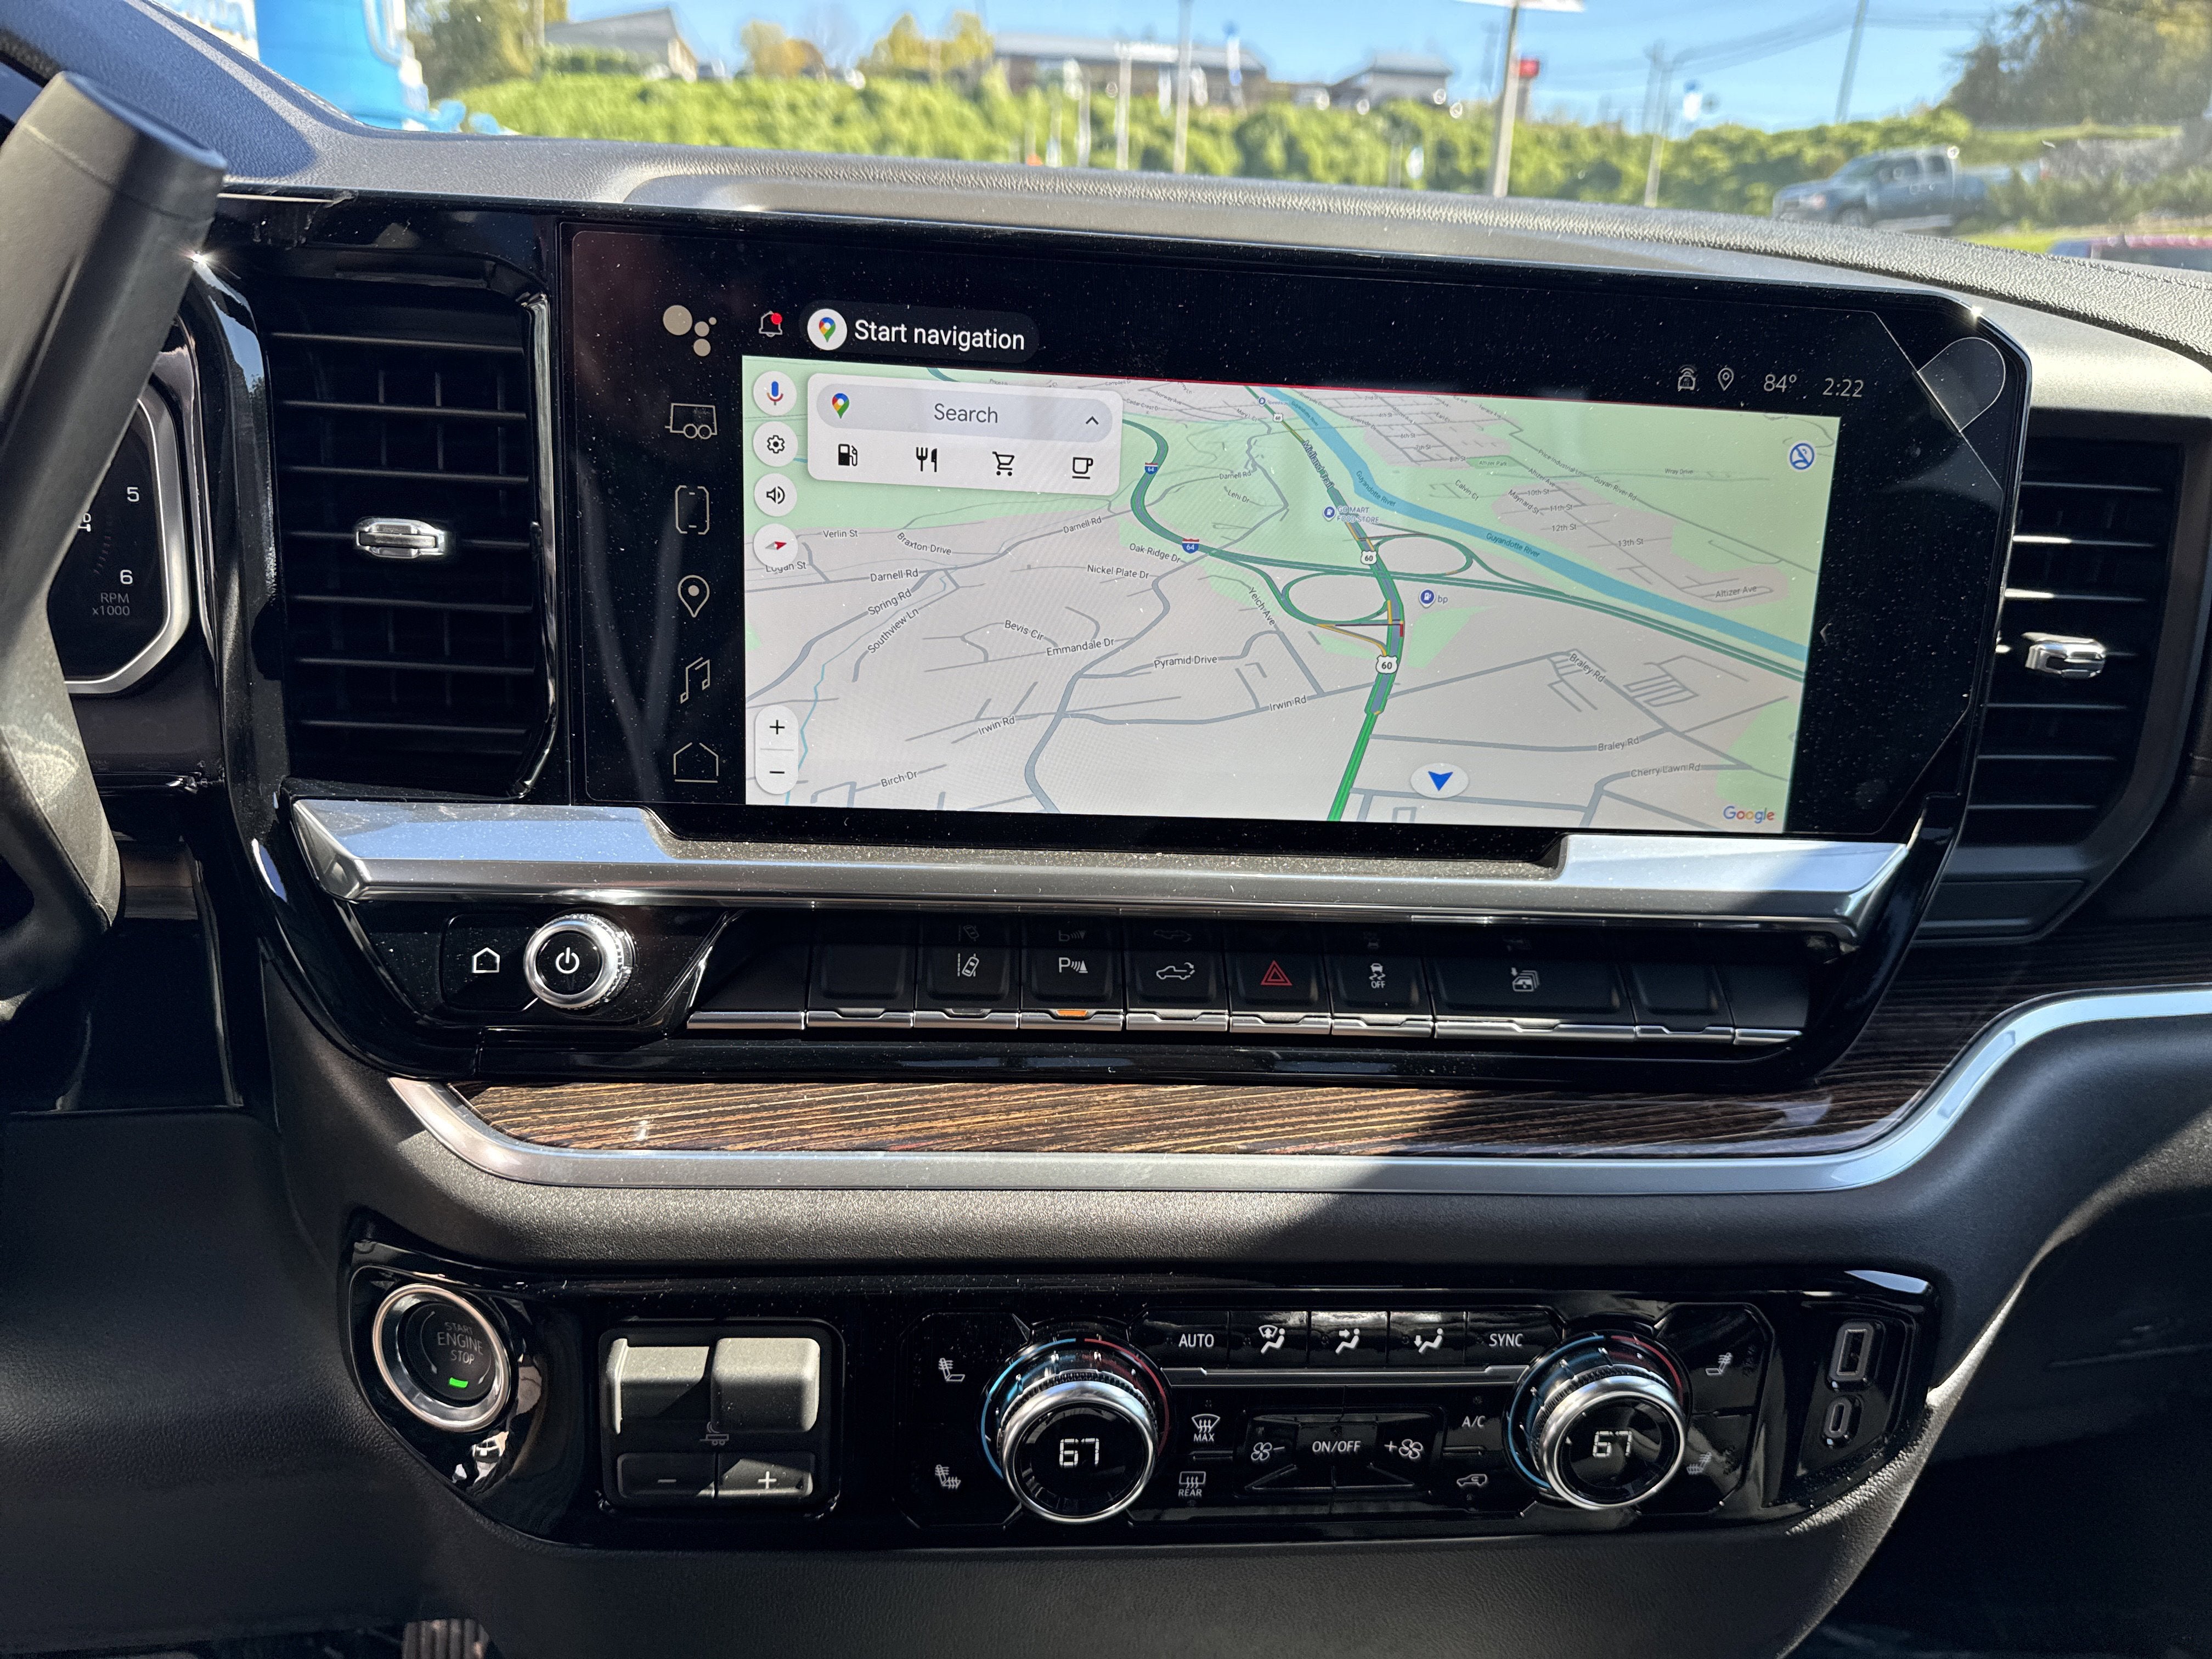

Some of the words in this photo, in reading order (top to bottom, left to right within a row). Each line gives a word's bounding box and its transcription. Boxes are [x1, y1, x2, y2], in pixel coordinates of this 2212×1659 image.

[855, 319, 909, 344] Start
[915, 326, 1025, 352] navigation
[1822, 378, 1864, 398] 2:22
[1155, 391, 1173, 402] Norway
[934, 403, 998, 424] Search
[1350, 416, 1371, 426] Riverside
[1538, 449, 1550, 460] Price
[1303, 440, 1323, 472] Midland
[1321, 470, 1335, 489] Trail
[1356, 470, 1381, 500] Guyandotte
[1380, 494, 1396, 506] River
[1455, 479, 1471, 496] Calvin
[1545, 478, 1555, 487] Ave
[1594, 476, 1612, 489] Guyan
[1613, 485, 1628, 496] River
[1628, 493, 1638, 501] Rd
[127, 487, 140, 502] 5
[1227, 489, 1240, 500] Lehi
[1242, 495, 1250, 503] Dr
[1508, 489, 1534, 510] Maynard
[1533, 506, 1540, 515] St
[1064, 520, 1090, 534] Darnell
[1091, 516, 1102, 526] Rd
[823, 530, 847, 538] Verlin
[848, 529, 859, 538] St
[897, 533, 928, 551] Braxton
[930, 545, 952, 555] Drive
[1486, 533, 1523, 551] Guyandotte
[1523, 545, 1541, 558] River
[1130, 544, 1145, 554] Oak
[1148, 548, 1170, 561] Ridge
[1171, 554, 1181, 563] Dr
[797, 561, 806, 569] St
[1087, 565, 1114, 575] Nickel
[1116, 567, 1137, 578] Plate
[1139, 570, 1149, 579] Dr
[120, 569, 134, 585] 6
[870, 570, 903, 582] Darnell
[906, 568, 919, 578] Rd
[100, 592, 129, 603] RPM
[1437, 595, 1448, 603] bp
[1715, 588, 1741, 599] Altizer
[1742, 585, 1757, 594] Ave
[92, 606, 130, 616] x1000
[867, 596, 898, 617] Spring
[898, 589, 912, 601] Rd
[1249, 587, 1265, 610] Yeich
[1262, 611, 1275, 625] Ave
[867, 617, 907, 653] Southview
[906, 608, 919, 620] Ln
[1005, 620, 1029, 635] Bevis
[1030, 629, 1045, 641] Cir
[1046, 641, 1102, 656] Emmandale
[1104, 637, 1115, 646] Dr
[1153, 656, 1192, 669] Pyramid
[1194, 654, 1217, 664] Drive
[1381, 662, 1392, 670] 60
[1570, 653, 1594, 674] Braley
[1593, 670, 1606, 682] Rd
[1269, 698, 1293, 712] Irwin
[1294, 695, 1307, 706] Rd
[978, 720, 1001, 736] Irwin
[1003, 716, 1015, 726] Rd
[1598, 740, 1625, 752] Braley
[1627, 736, 1640, 746] Rd
[1630, 768, 1661, 778] Cherry
[1662, 764, 1686, 774] Lawn
[1688, 763, 1701, 772] Rd
[881, 772, 905, 788] Birch
[907, 770, 918, 780] Dr
[1723, 805, 1775, 823] Google
[444, 1322, 473, 1335] START
[437, 1331, 483, 1356] ENGINE
[1178, 1333, 1215, 1348] AUTO
[1488, 1333, 1523, 1347] SYNC
[451, 1349, 475, 1365] STOP
[1462, 1415, 1485, 1427] A/C
[1193, 1432, 1215, 1442] MAX
[1592, 1430, 1633, 1458] 67
[1059, 1437, 1100, 1469] 67
[1312, 1441, 1361, 1454] ON/OFF
[1178, 1487, 1203, 1497] REAR
